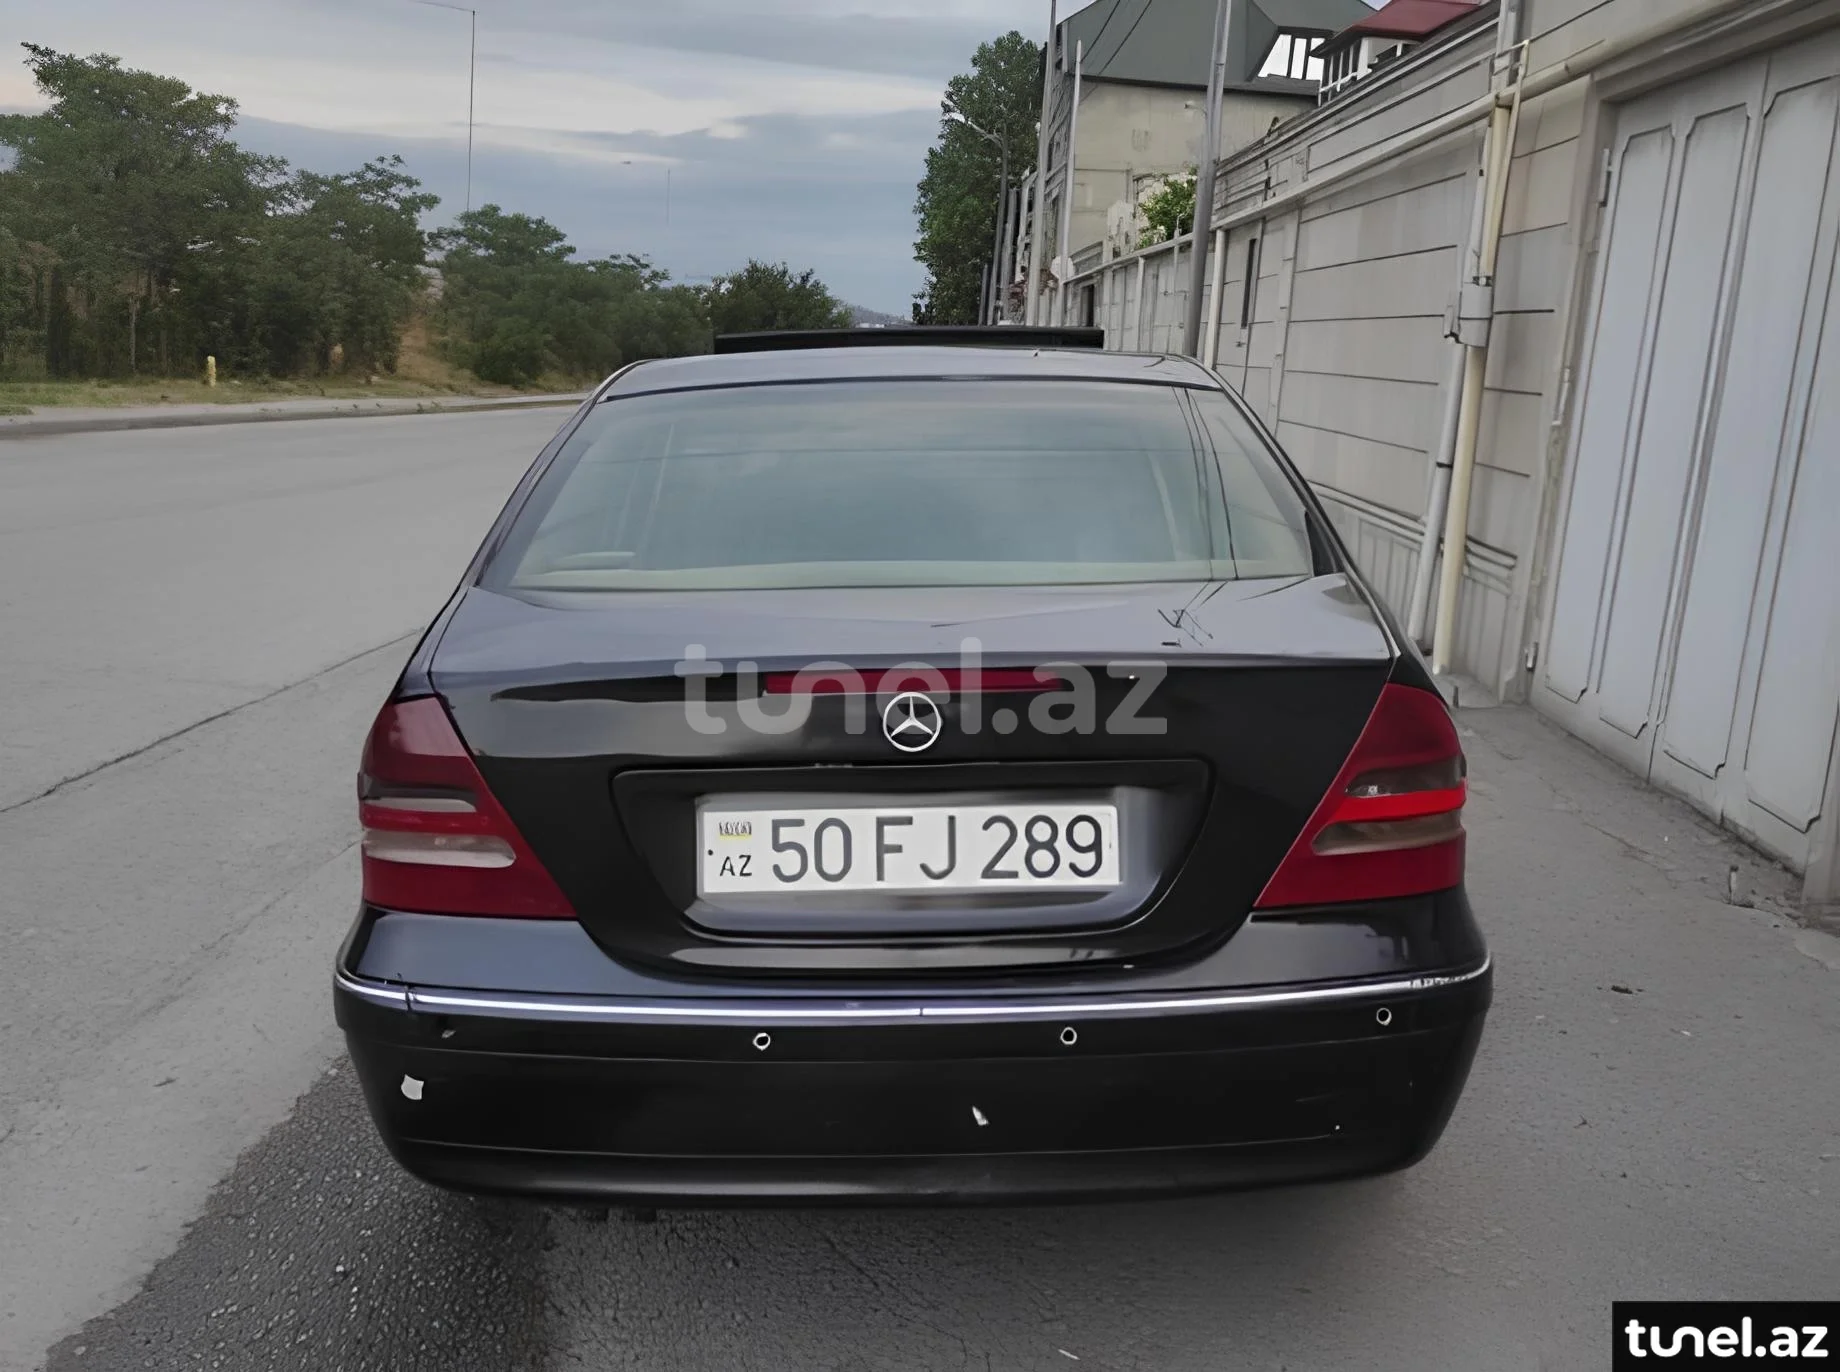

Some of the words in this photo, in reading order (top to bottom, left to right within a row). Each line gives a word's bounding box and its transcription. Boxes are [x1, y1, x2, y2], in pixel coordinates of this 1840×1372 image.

[719, 854, 752, 877] AZ
[770, 817, 853, 883] 50
[875, 815, 957, 881] FJ
[981, 814, 1103, 879] 289
